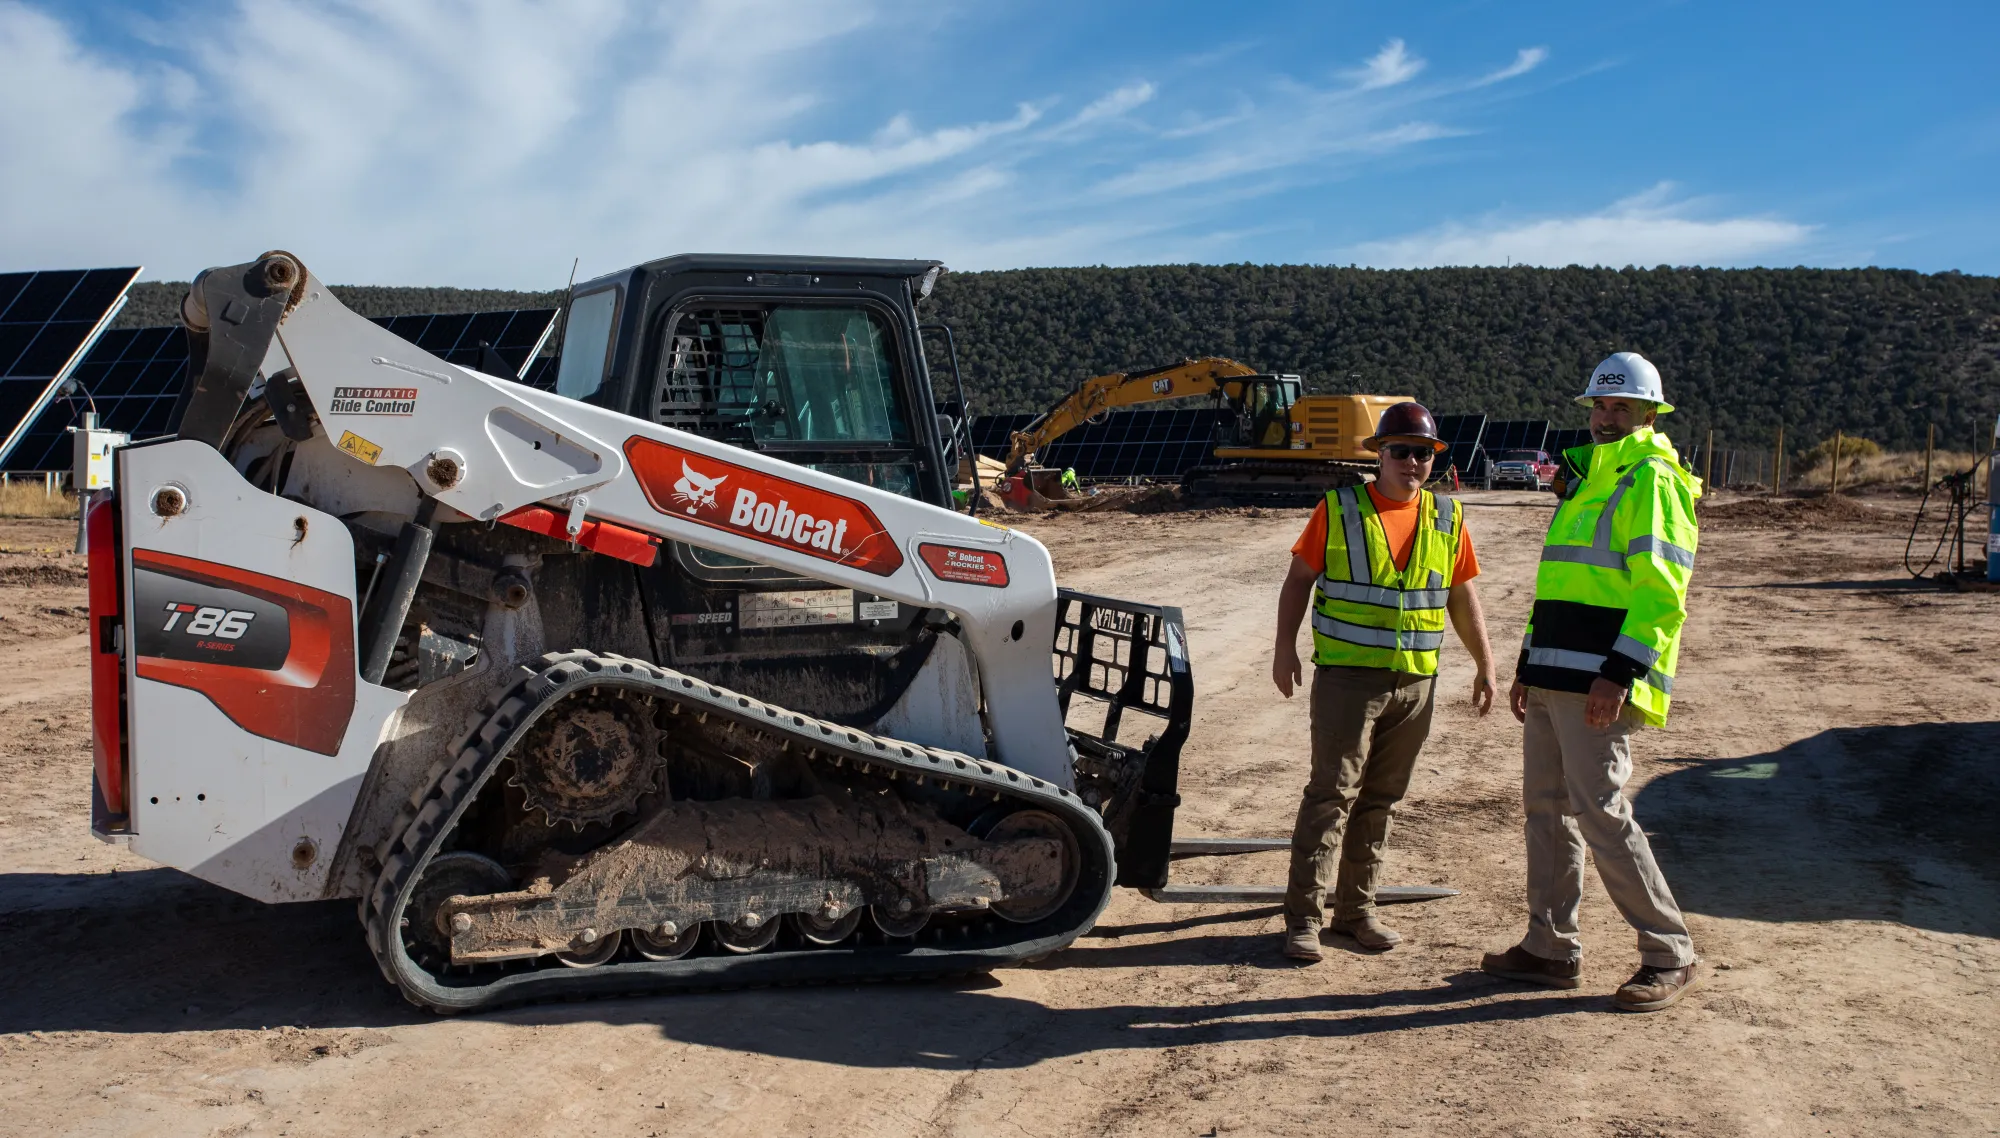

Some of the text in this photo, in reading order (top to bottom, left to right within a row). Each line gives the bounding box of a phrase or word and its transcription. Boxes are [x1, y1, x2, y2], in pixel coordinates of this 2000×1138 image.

[1597, 373, 1625, 385] aes
[1152, 378, 1169, 394] CAT
[337, 388, 415, 399] AUTOMATIC
[330, 399, 415, 413] Ride Control
[729, 487, 848, 555] Bobcat
[959, 552, 984, 563] Bobcat
[951, 561, 985, 570] ROCKIES
[162, 601, 256, 640] T86
[697, 612, 733, 624] SPEED
[196, 640, 235, 652] R-SERIES
